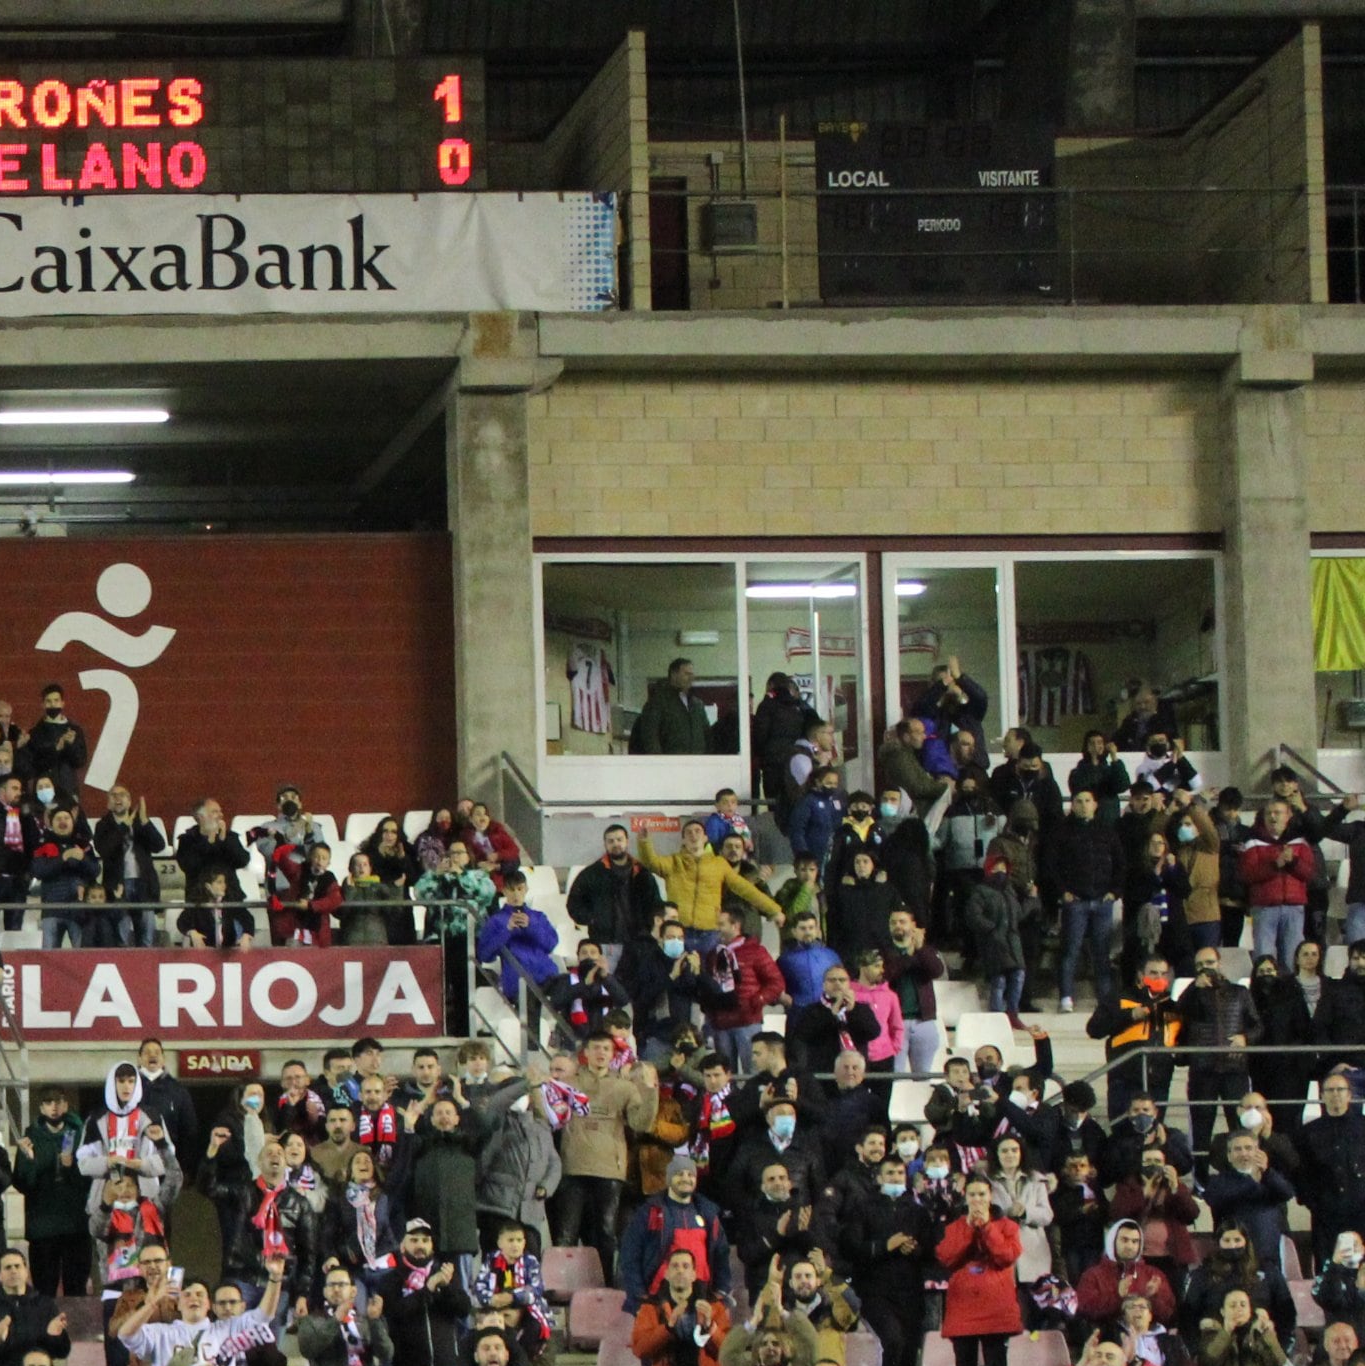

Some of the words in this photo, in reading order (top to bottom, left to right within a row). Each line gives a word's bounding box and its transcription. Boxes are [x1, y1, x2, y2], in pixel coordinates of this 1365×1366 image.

[434, 75, 463, 123] 1
[437, 138, 471, 186] 0
[828, 170, 890, 188] LOCAL
[978, 170, 1040, 187] VISITANTE
[917, 218, 961, 231] PERIODO
[161, 864, 176, 874] 23
[21, 962, 142, 1029] LA
[158, 960, 436, 1028] RIOJA
[187, 1055, 253, 1071] SALIDA
